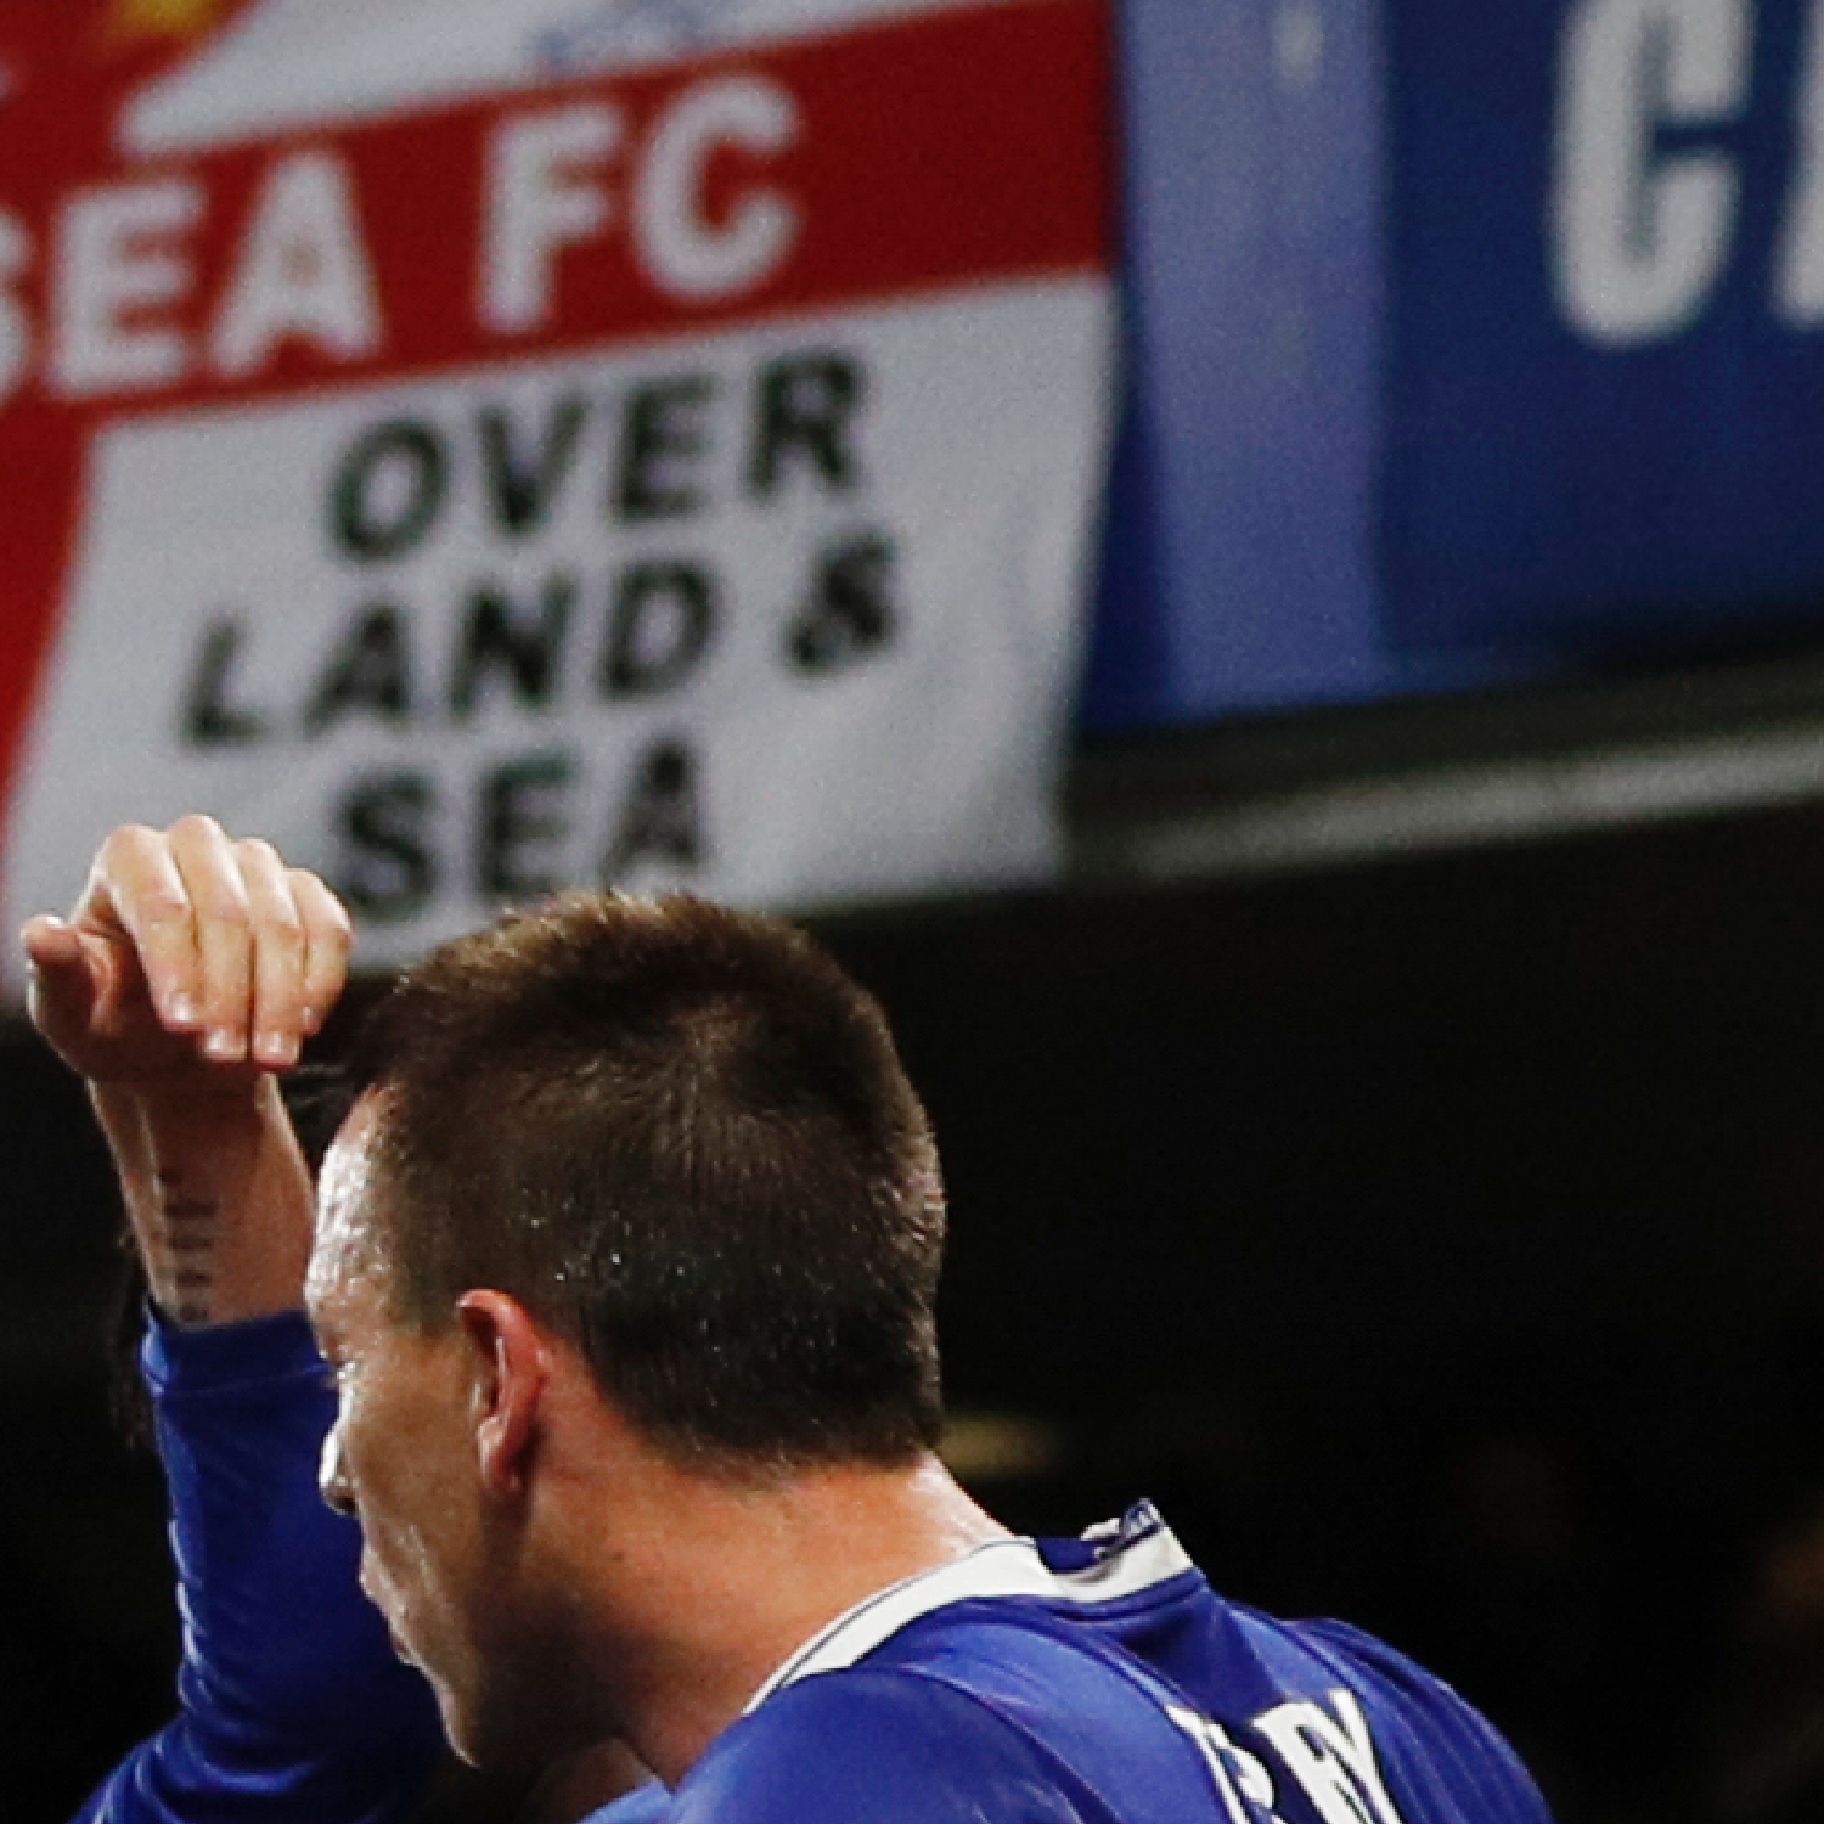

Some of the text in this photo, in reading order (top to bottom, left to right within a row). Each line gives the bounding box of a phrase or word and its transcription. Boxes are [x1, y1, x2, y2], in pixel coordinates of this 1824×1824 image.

[472, 72, 804, 336] FC
[322, 348, 867, 564] OVER
[176, 530, 901, 754] LAND &
[334, 735, 708, 918] SEA
